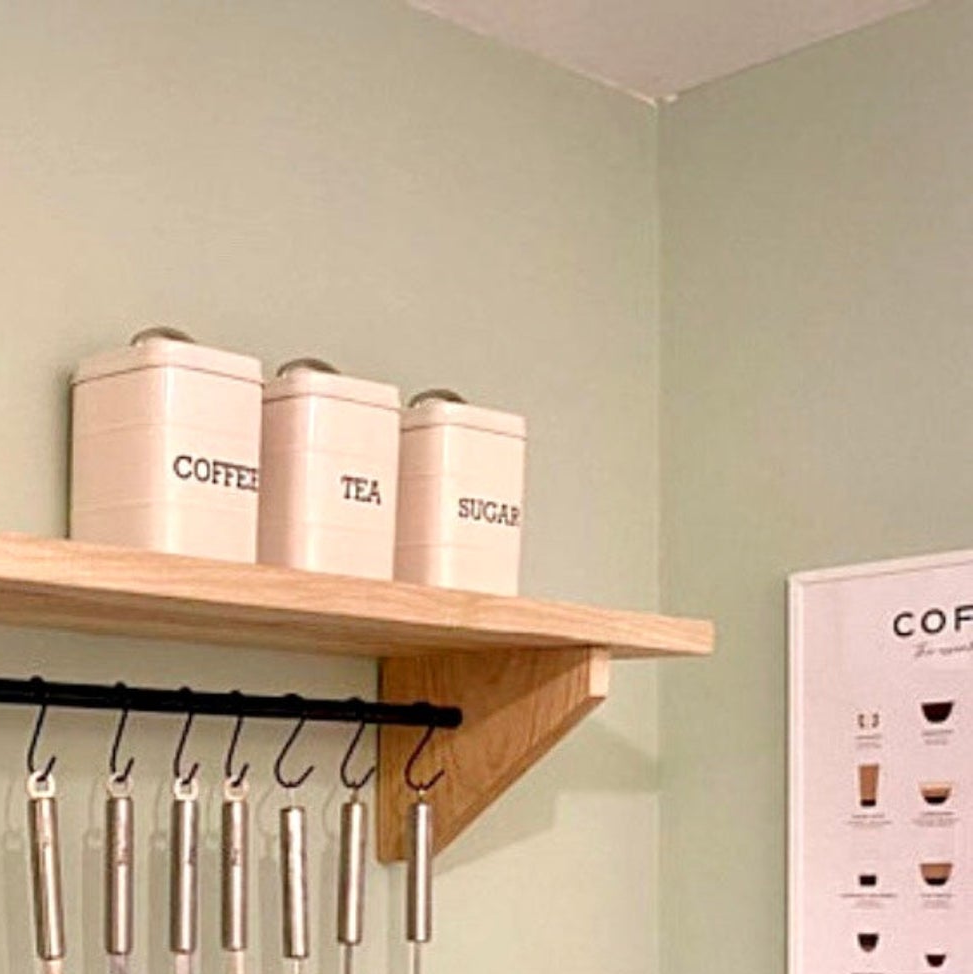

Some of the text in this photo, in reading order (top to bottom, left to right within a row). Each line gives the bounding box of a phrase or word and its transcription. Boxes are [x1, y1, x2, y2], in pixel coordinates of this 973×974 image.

[173, 455, 257, 492] COFFEE
[340, 475, 381, 506] TEA
[458, 498, 521, 527] SUGAR
[893, 604, 973, 638] COF
